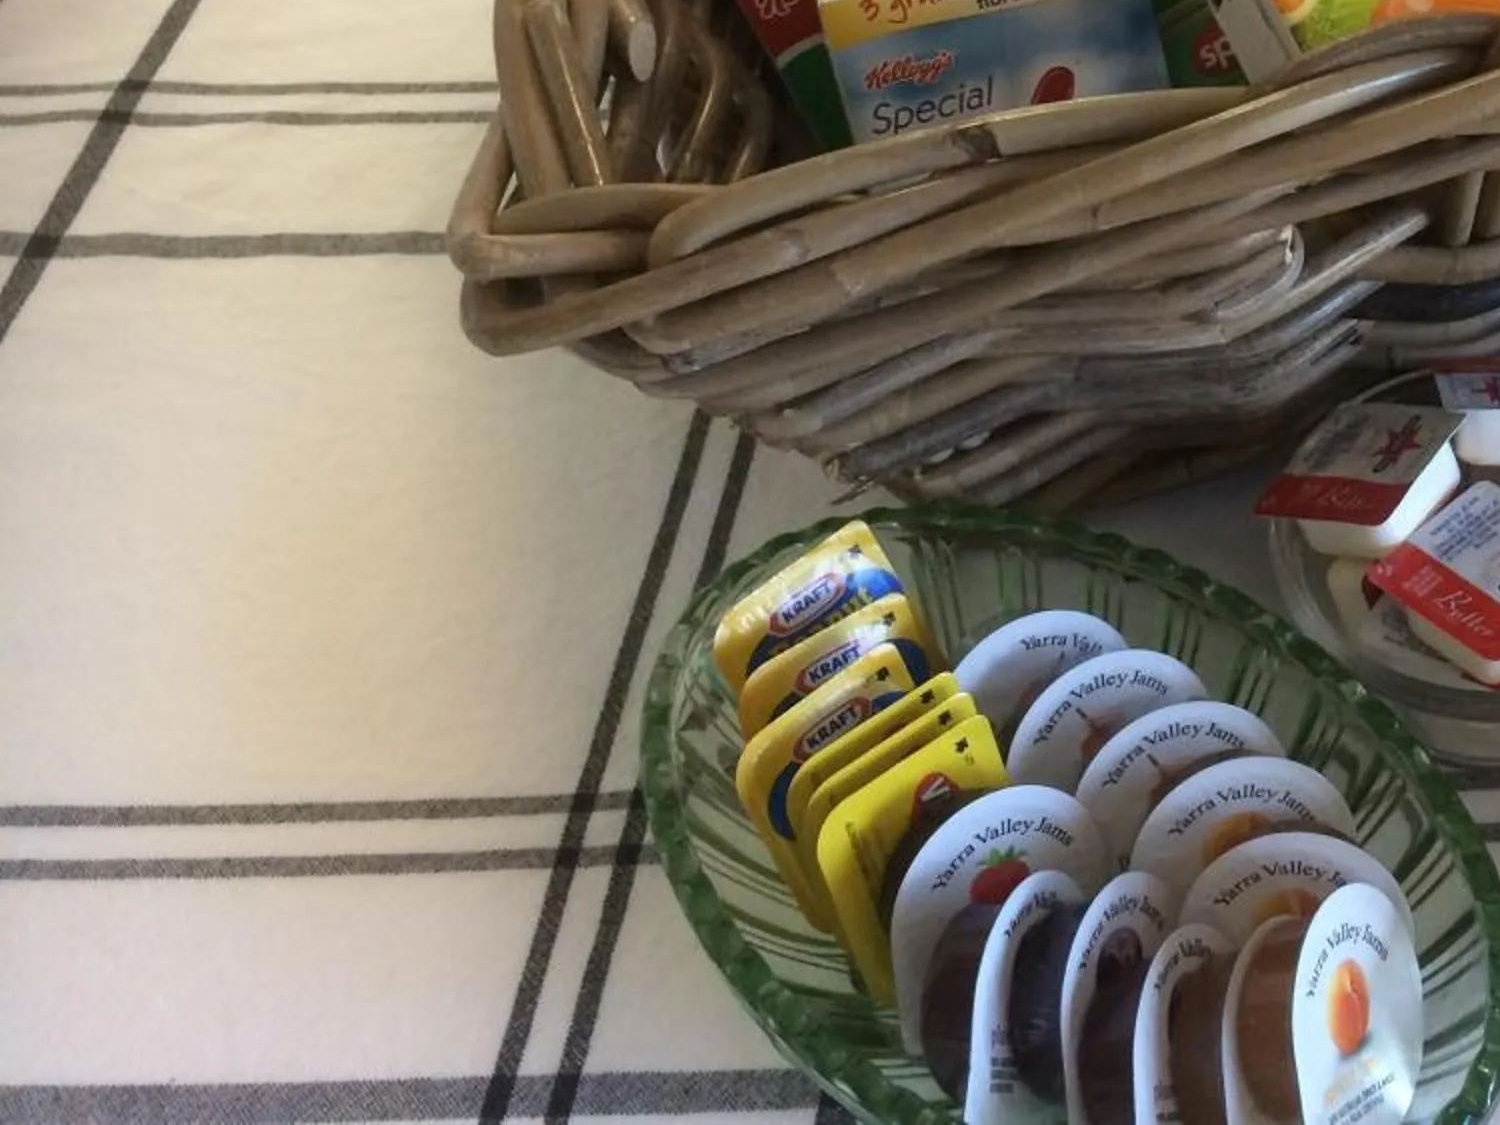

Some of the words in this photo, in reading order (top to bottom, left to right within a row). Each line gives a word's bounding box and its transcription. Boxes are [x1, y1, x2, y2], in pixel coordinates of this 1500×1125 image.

[1199, 36, 1237, 69] sp
[871, 77, 995, 136] Special
[780, 578, 835, 624] KRAFT
[806, 642, 863, 686] KRAFT
[1019, 633, 1069, 653] Yarra
[805, 706, 861, 750] KRAFT
[1032, 699, 1073, 747] Yarra
[1069, 669, 1130, 701] Valley
[1129, 669, 1170, 697] Jams
[1102, 744, 1146, 790] Yarra
[1142, 721, 1206, 748] Valley
[1204, 722, 1246, 749] Jams
[1167, 798, 1217, 838] Yarra
[1216, 784, 1279, 804] Valley
[1277, 789, 1318, 823] Jams
[931, 843, 977, 893] Yarra
[975, 818, 1035, 846] Valley
[1033, 815, 1075, 848] Jams
[1213, 871, 1262, 909] Yarra
[1261, 859, 1326, 879] Valley
[1305, 947, 1329, 999] Yarra
[1326, 922, 1364, 950] Valley
[1360, 922, 1390, 962] Jams
